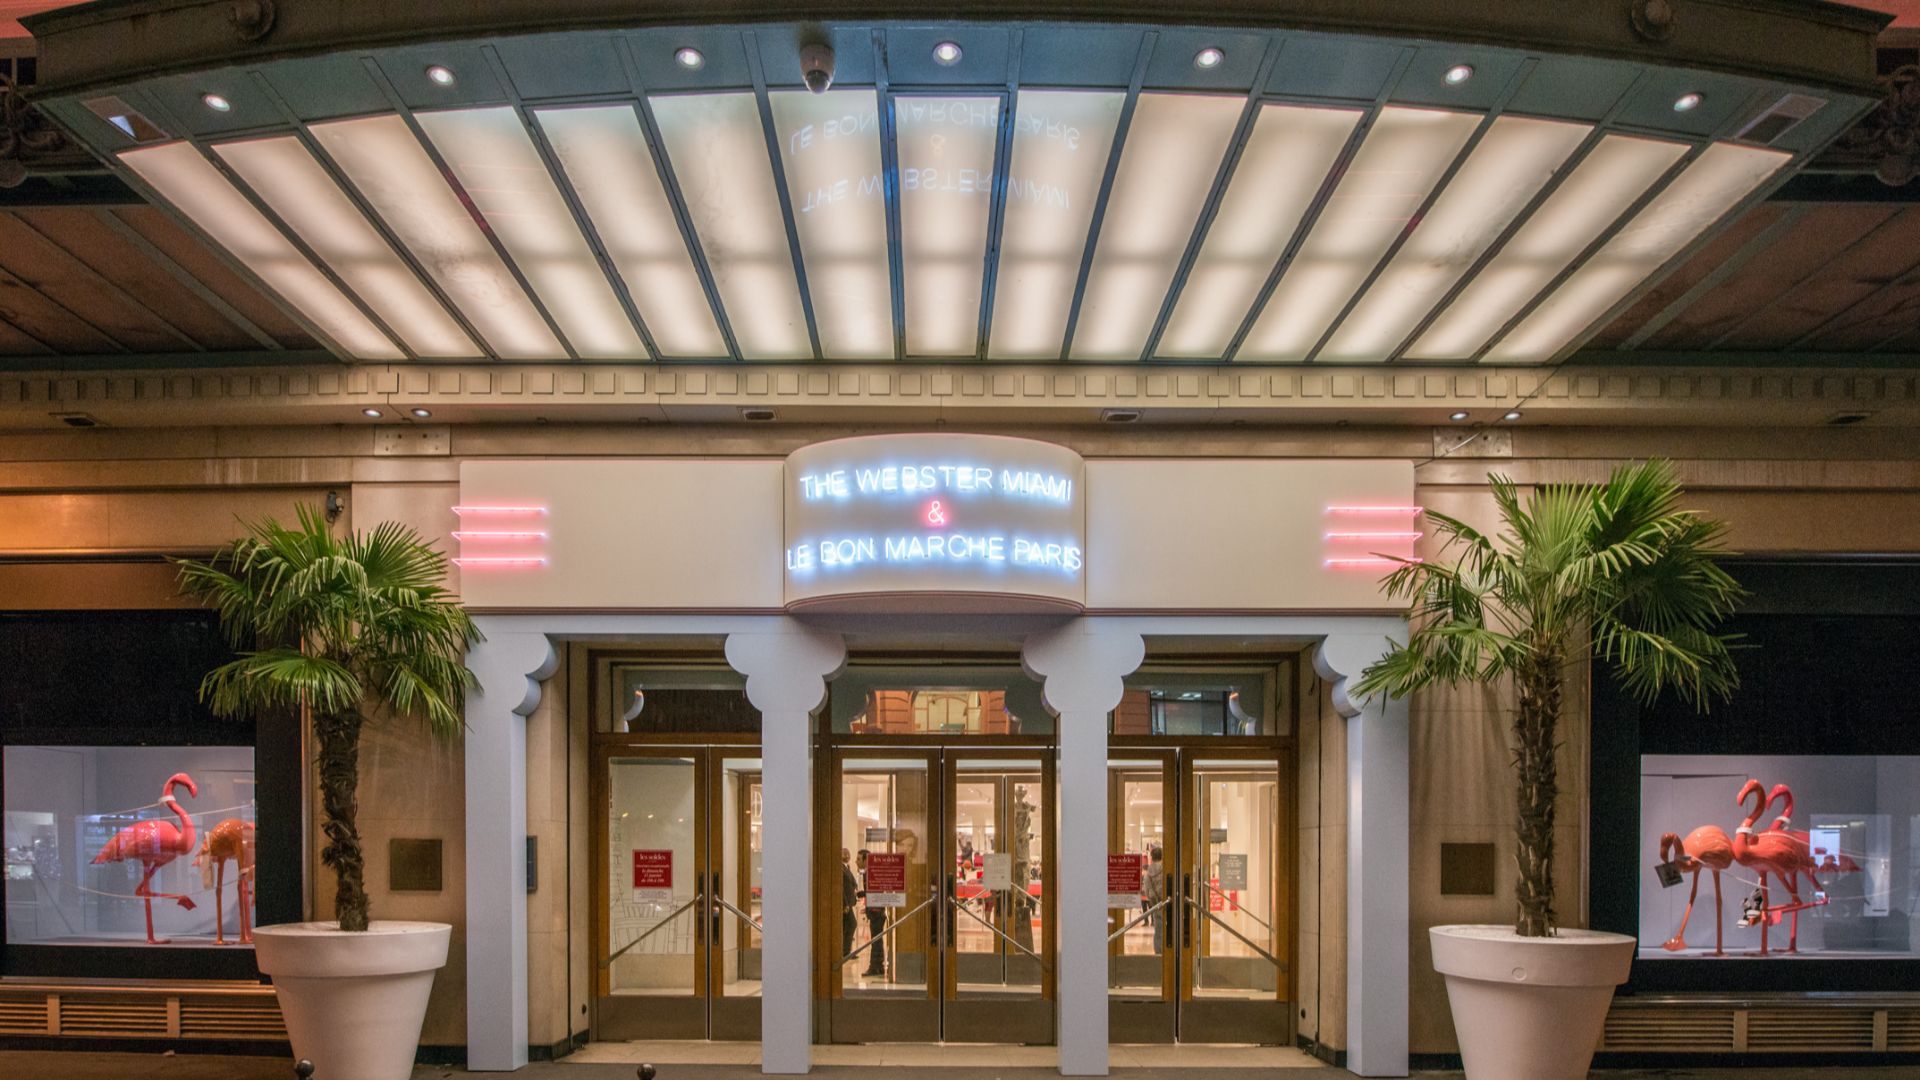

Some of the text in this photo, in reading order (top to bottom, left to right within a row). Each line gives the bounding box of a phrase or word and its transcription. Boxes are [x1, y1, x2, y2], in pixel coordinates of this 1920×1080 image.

[800, 466, 1072, 501] THE WEBSTER MIAMI
[927, 500, 945, 524] &
[787, 534, 1081, 571] LE BON MARCHE PARIS
